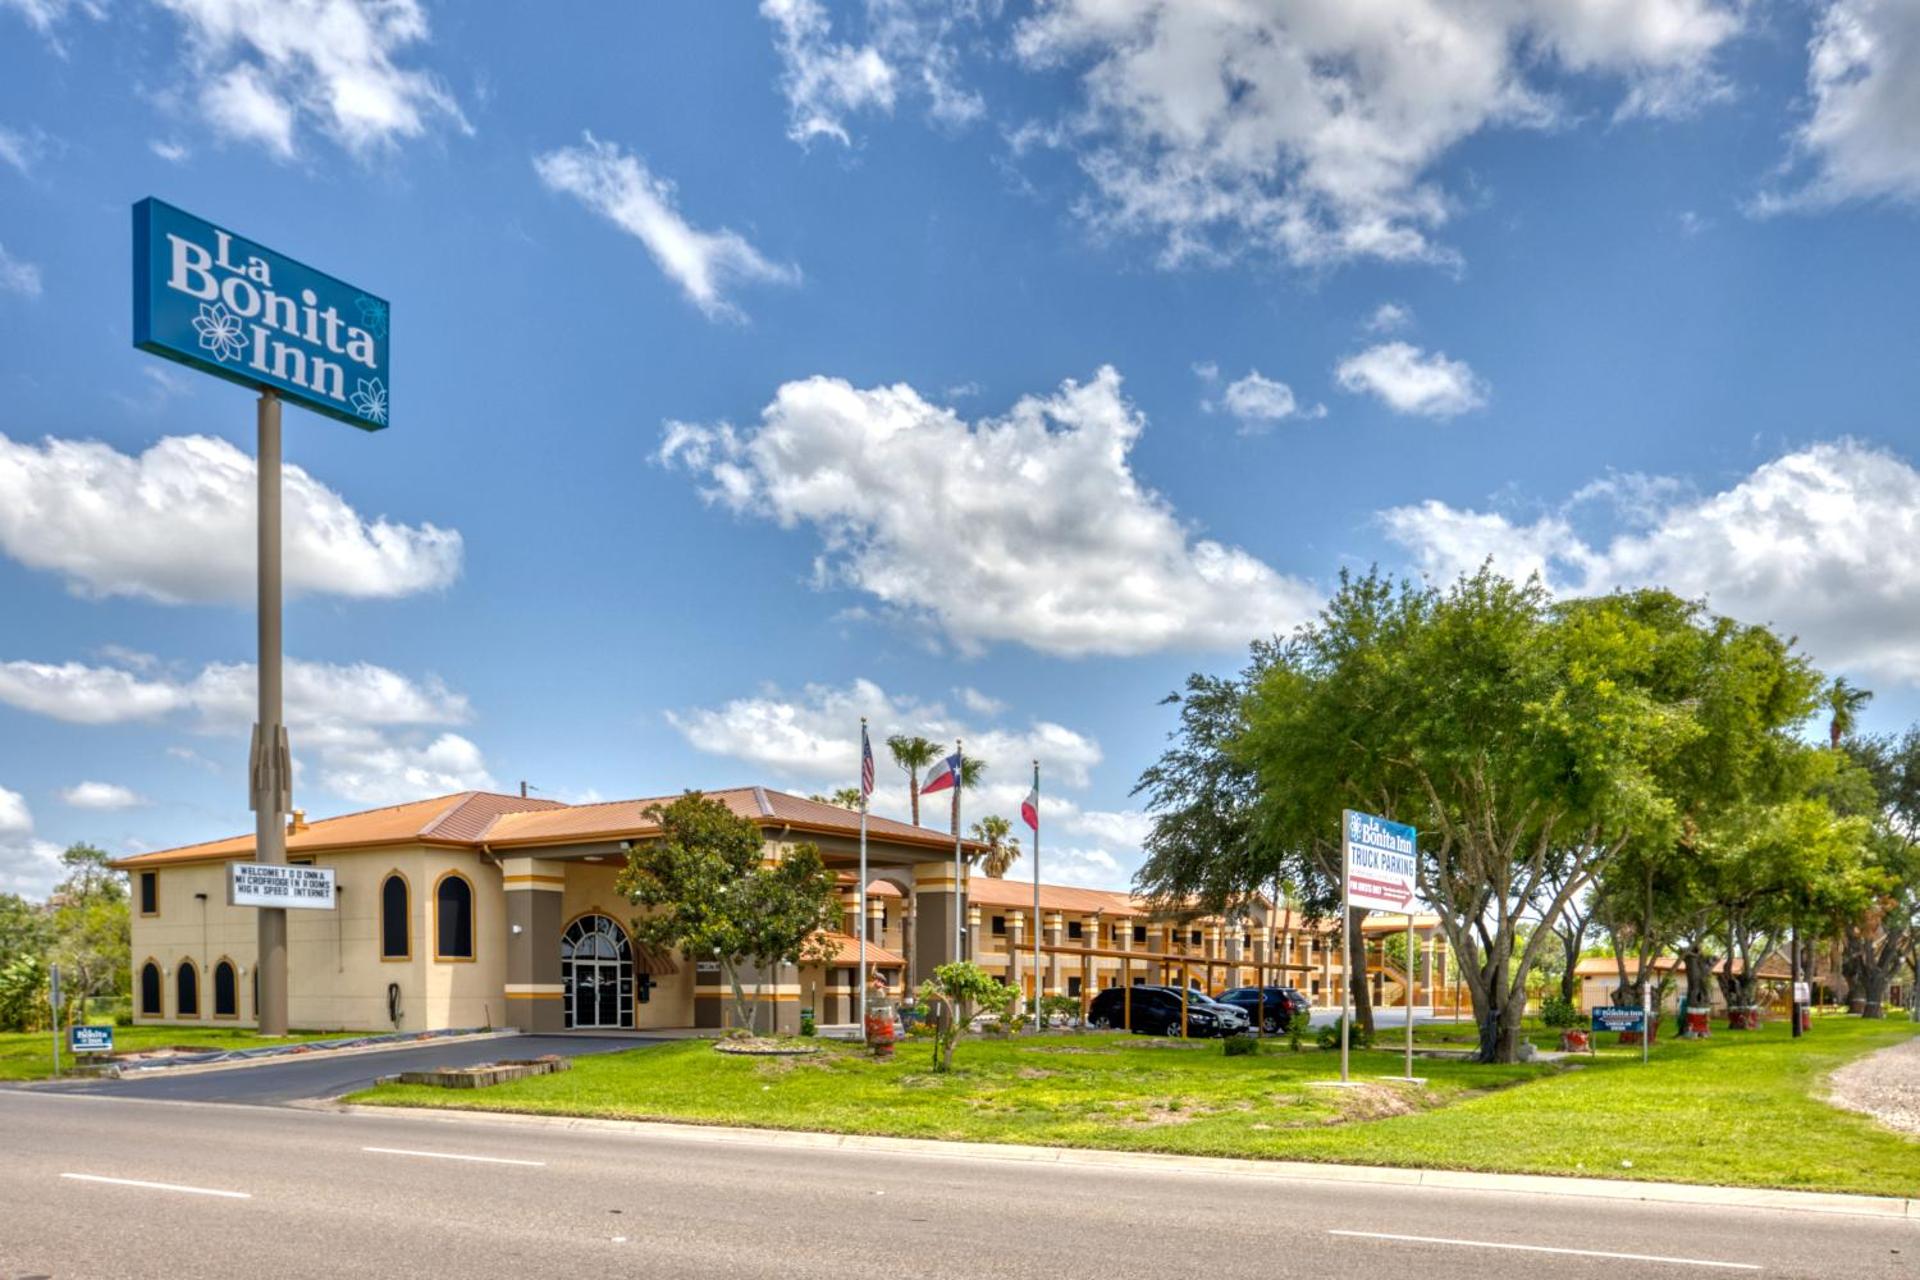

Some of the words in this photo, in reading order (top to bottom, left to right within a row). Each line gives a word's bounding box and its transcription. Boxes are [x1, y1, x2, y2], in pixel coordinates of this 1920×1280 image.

[214, 229, 273, 287] La
[166, 232, 377, 369] Bonita
[249, 323, 347, 402] Inn
[1362, 823, 1396, 850] Bonita
[1396, 835, 1412, 854] Inn
[240, 867, 279, 877] WELCOME
[1351, 846, 1380, 869] TRUCK
[1380, 853, 1414, 877] PARKING
[237, 885, 260, 894] HIGH
[263, 886, 289, 896] SPEED
[293, 887, 331, 898] INTERNET
